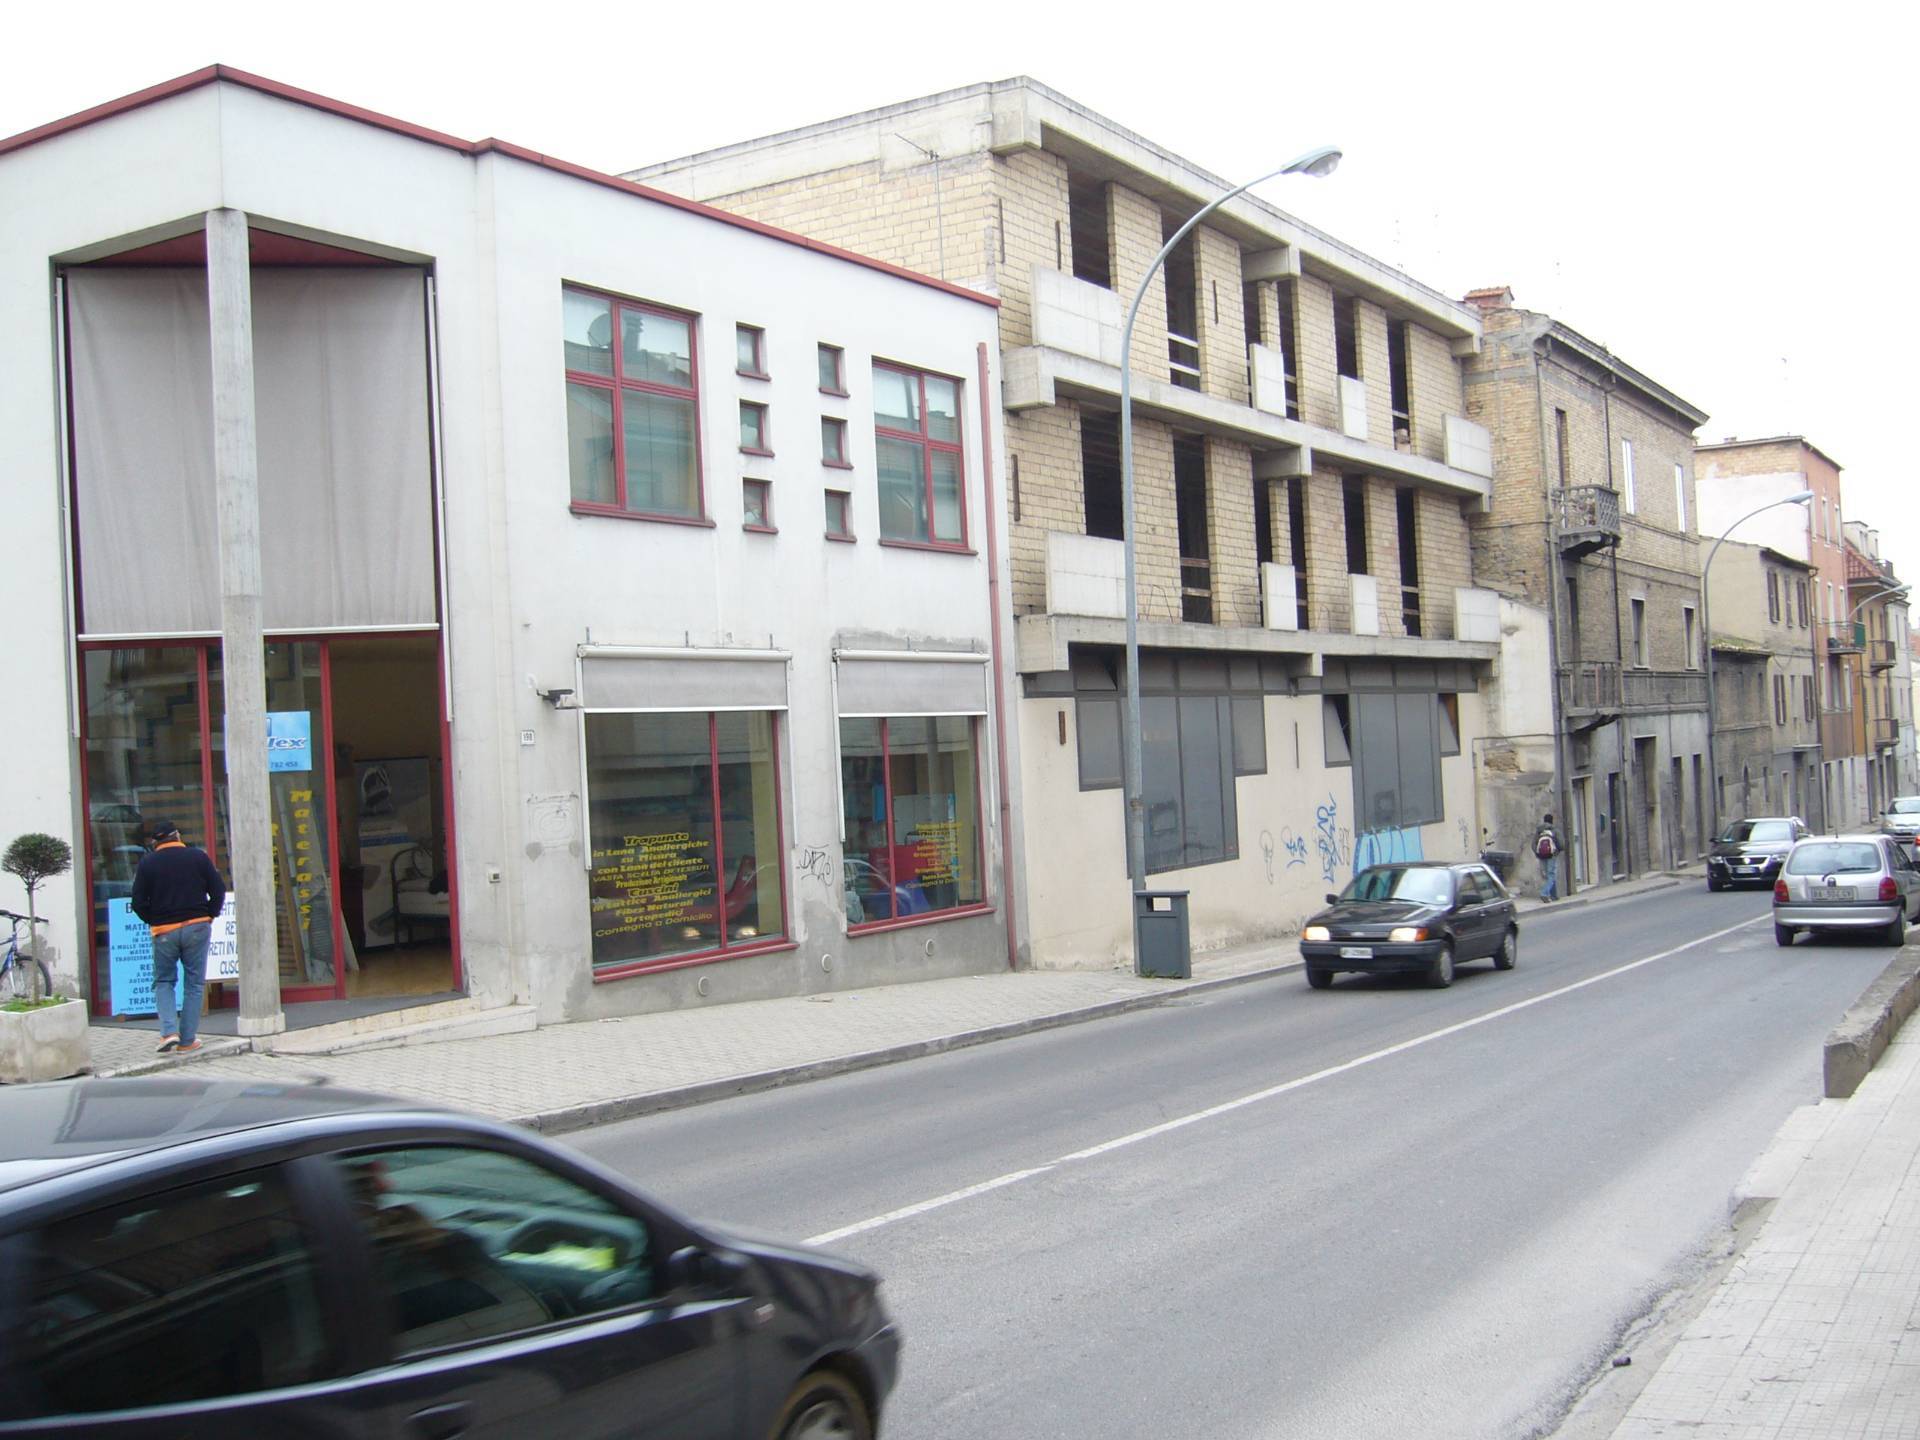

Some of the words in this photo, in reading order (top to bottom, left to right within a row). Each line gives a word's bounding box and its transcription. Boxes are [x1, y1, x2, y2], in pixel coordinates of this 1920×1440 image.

[624, 832, 690, 847] Trapunte
[628, 882, 680, 898] Cuscini
[595, 922, 653, 937] Consegna
[665, 912, 713, 926] Domicilio
